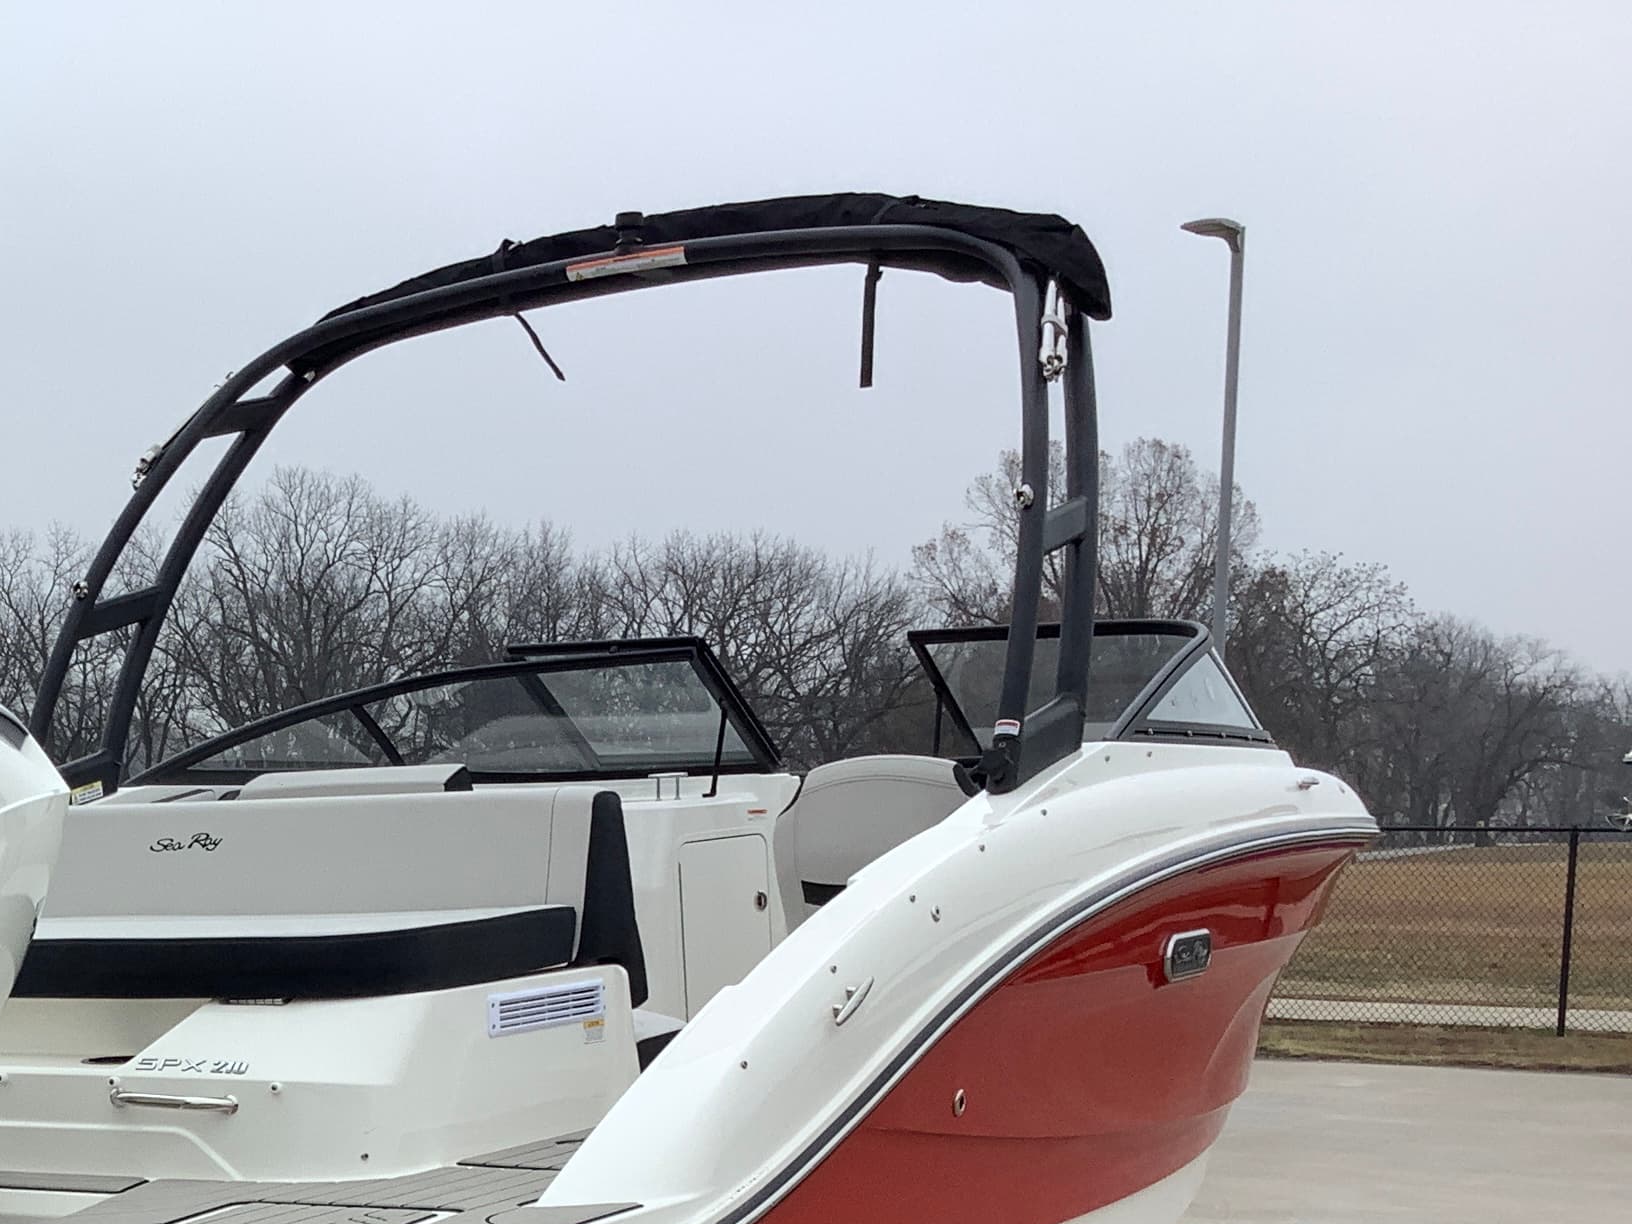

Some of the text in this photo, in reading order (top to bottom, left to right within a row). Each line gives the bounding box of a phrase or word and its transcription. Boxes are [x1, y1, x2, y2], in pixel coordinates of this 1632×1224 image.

[150, 833, 223, 852] Sea Ray
[135, 1058, 207, 1072] SPX
